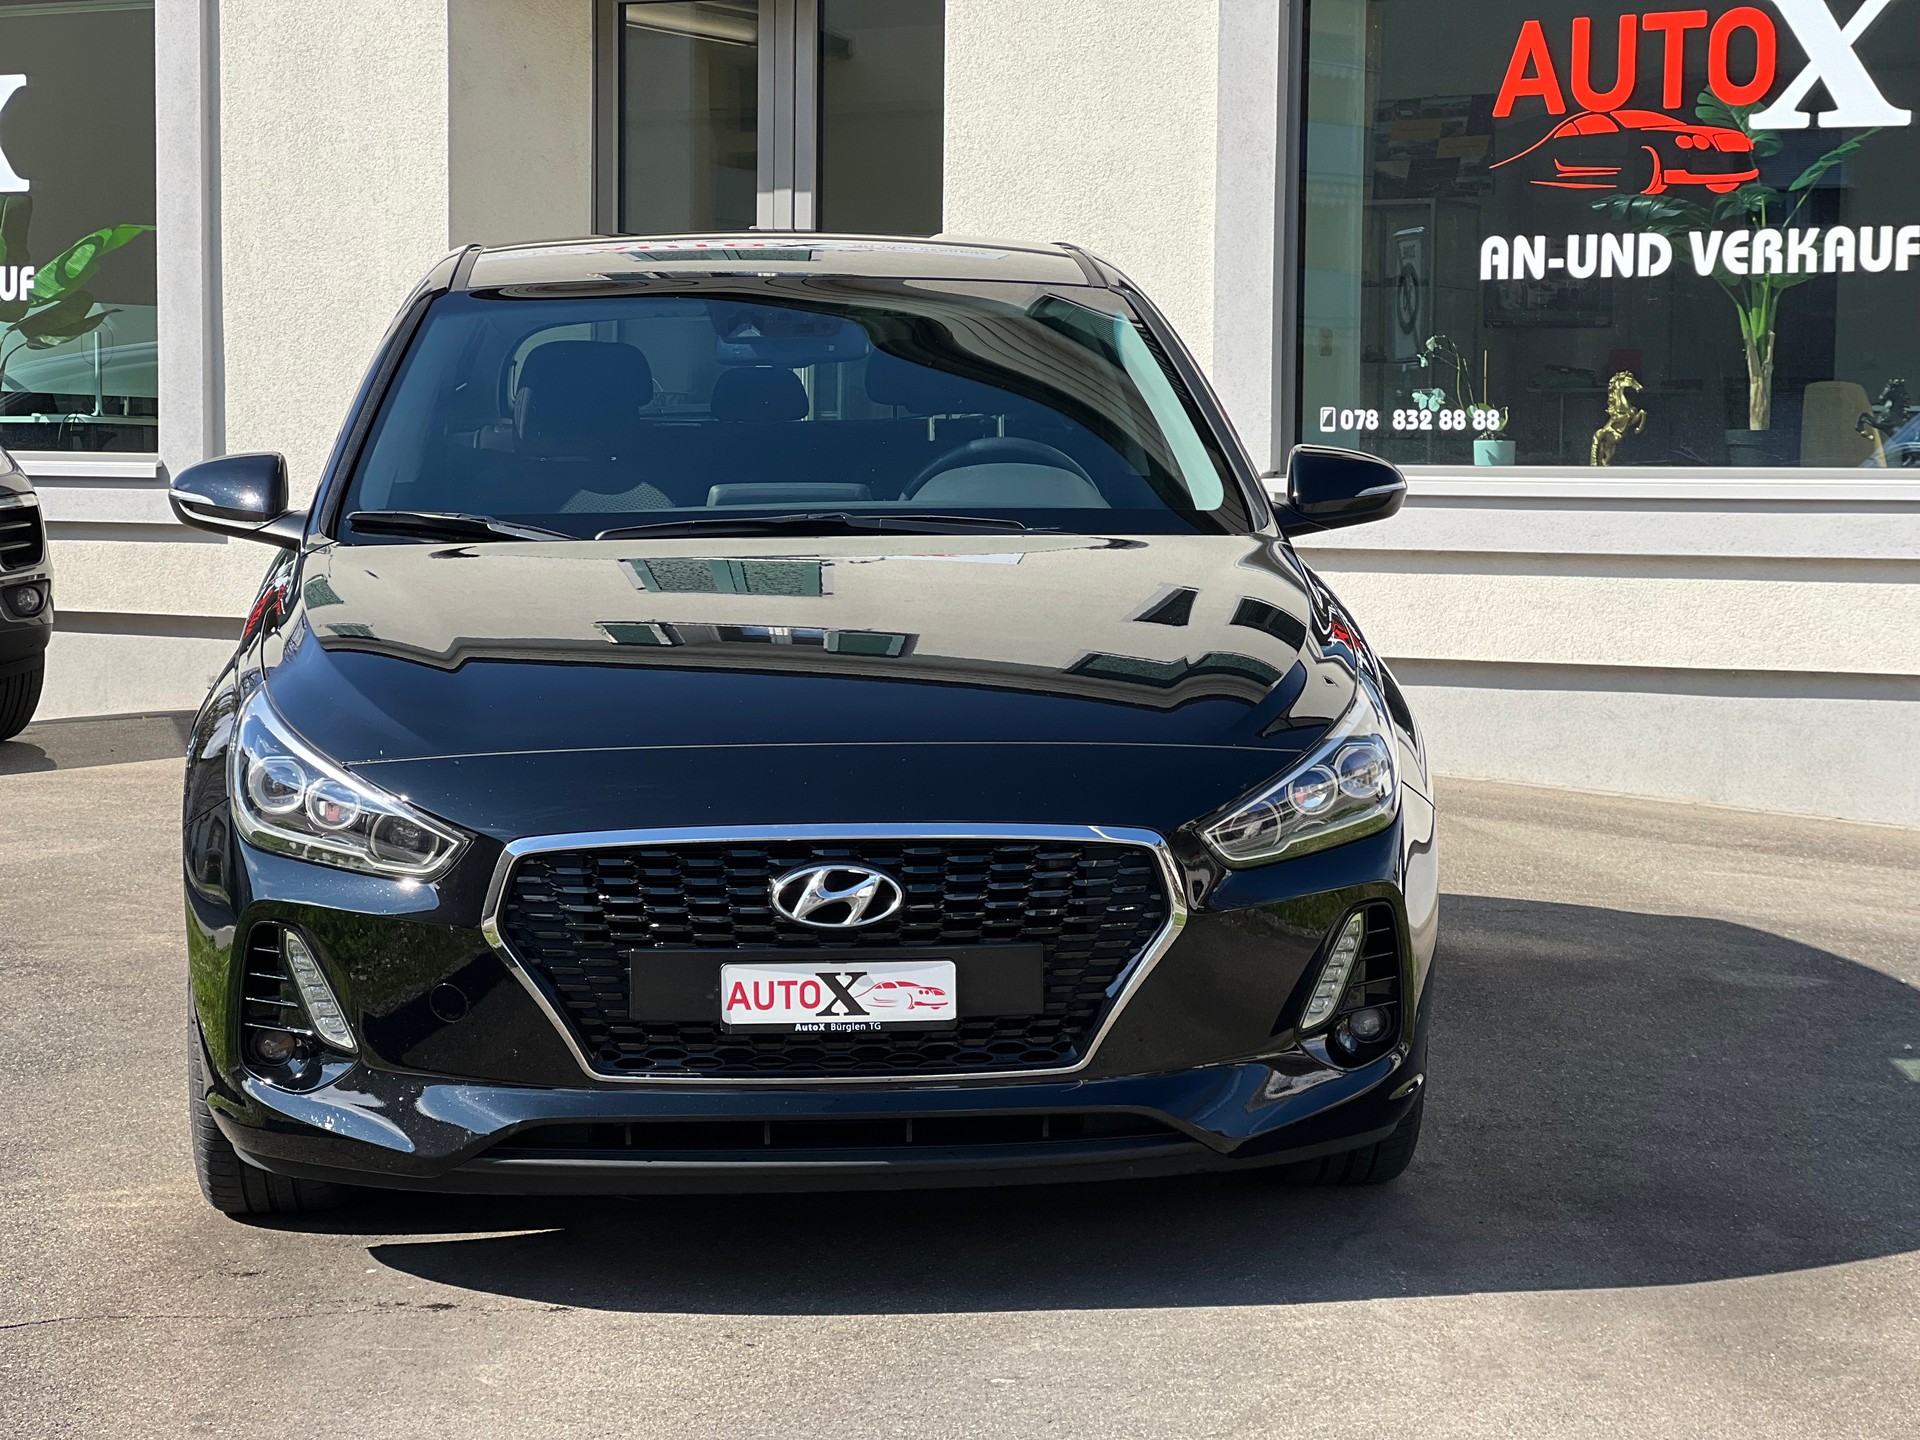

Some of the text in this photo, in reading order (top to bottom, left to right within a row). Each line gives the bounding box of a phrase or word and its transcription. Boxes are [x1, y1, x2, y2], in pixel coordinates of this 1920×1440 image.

[1480, 225, 1920, 280] AN-UND VERKAUF
[1340, 409, 1500, 430] 078 832 88 88
[794, 1022, 881, 1033] AutoX Bürglen TG
